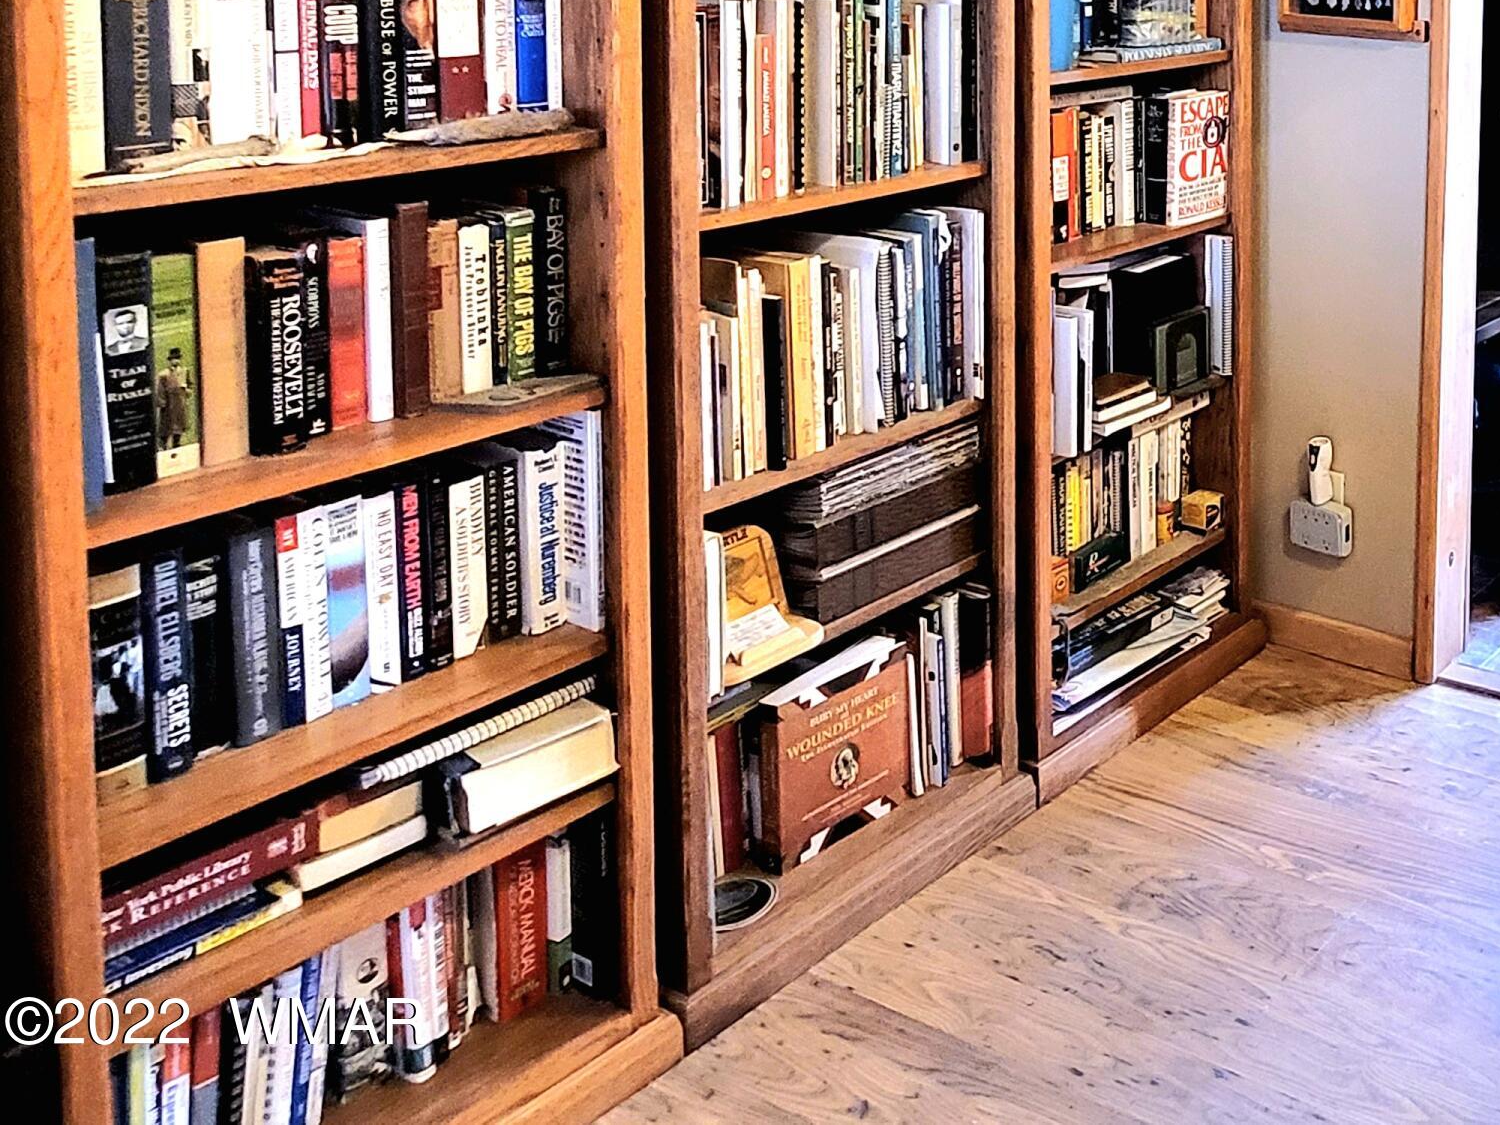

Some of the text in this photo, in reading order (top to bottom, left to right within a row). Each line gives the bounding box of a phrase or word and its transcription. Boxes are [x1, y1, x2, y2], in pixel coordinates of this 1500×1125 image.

[306, 5, 317, 49] FINAL
[324, 4, 358, 45] COUP
[495, 19, 506, 36] TO
[132, 7, 151, 136] RICHARD NIXON
[307, 50, 319, 89] DAYS
[496, 38, 506, 71] HEAL
[891, 63, 902, 100] MARIA
[382, 61, 398, 118] POWER
[1180, 95, 1229, 123] ESCAPE
[891, 101, 902, 156] MARTINEZ
[1180, 136, 1201, 151] THE
[1179, 145, 1227, 182] CIA
[513, 234, 535, 356] THE BAY OF PIGS
[546, 215, 566, 326] BAY OF PIGS
[307, 276, 320, 329] SCORPIONS
[108, 365, 147, 378] TEAM
[281, 294, 304, 418] ROOSEVELT
[108, 387, 152, 402] RIVALS
[281, 528, 294, 547] MY
[377, 508, 391, 528] NO
[469, 482, 484, 558] BRADLEY
[502, 466, 517, 619] AMERICAN SOLDIER
[537, 482, 561, 606] Justice at Nuremberg
[378, 531, 394, 562] EASY
[402, 485, 422, 609] MEN FROM EARTH
[455, 506, 472, 626] A SOLDIER'S STORY
[488, 470, 500, 625] GENERAL TOMMY FRANKS
[153, 559, 177, 612] DANIEL
[283, 556, 297, 623] AMERICAN
[311, 517, 331, 686] COLIN POWELL
[379, 565, 394, 590] DAY
[157, 612, 183, 682] ELLSBERG
[285, 634, 302, 692] JOURNEY
[167, 683, 192, 748] SECRETS
[786, 693, 898, 760] WOUNDED KNEE
[809, 711, 833, 727] BURY
[850, 686, 879, 708] HEART
[203, 851, 253, 878] Library
[129, 864, 252, 926] REFERENCE
[518, 859, 537, 979] MERCK MANUAL
